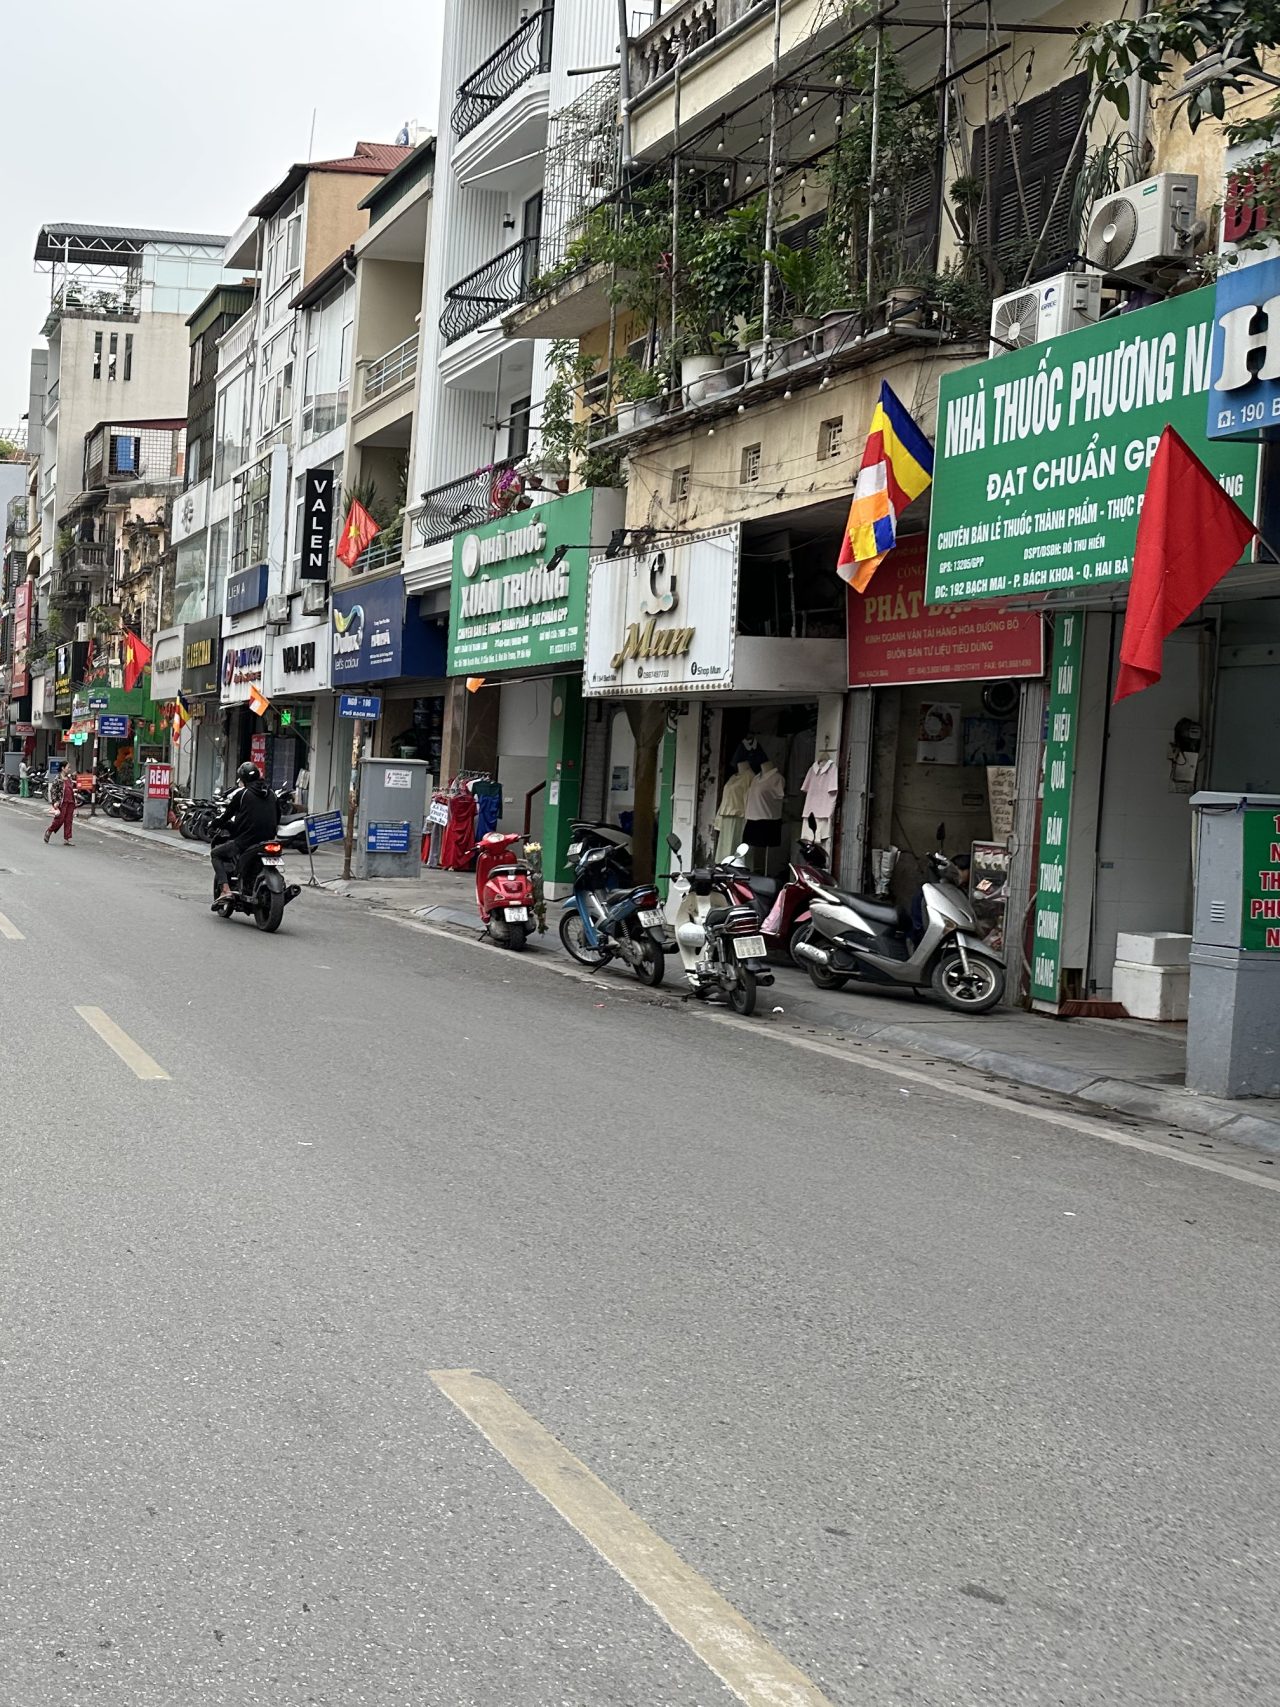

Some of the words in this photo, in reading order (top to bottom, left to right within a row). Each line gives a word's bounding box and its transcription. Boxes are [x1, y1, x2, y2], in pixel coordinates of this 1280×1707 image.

[944, 379, 985, 458] NHÀ
[993, 347, 1063, 446] THUỐC
[1069, 332, 1176, 426] PHƯƠNG
[1240, 402, 1265, 424] 190
[986, 466, 1027, 506] ĐẠT
[1033, 433, 1117, 492] CHUẨN
[1124, 436, 1161, 472] GP
[1219, 473, 1244, 498] ĂNG
[309, 479, 329, 567] VALEN
[480, 529, 506, 566] NHÀ
[506, 512, 547, 557] THUỐC
[937, 525, 969, 550] CHUYÊN
[971, 521, 989, 543] BÁN
[990, 516, 1002, 539] LẺ
[1003, 509, 1032, 538] THUỐC
[1034, 507, 1066, 533] THÀNH
[1067, 497, 1098, 527] PHẨM
[1107, 494, 1135, 524] THỰC
[460, 574, 502, 618] XUÂN
[503, 558, 569, 610] TRƯỜNG
[935, 586, 949, 599] ĐC:
[950, 583, 965, 597] 192
[966, 580, 988, 596] BẠCH
[989, 576, 1006, 590] MAI
[1023, 569, 1047, 586] BÁCH
[1049, 567, 1074, 583] KHOA
[1083, 565, 1092, 579] Q.
[1095, 562, 1112, 577] HAI
[1115, 557, 1128, 575] BÀ
[864, 584, 922, 624] PHÁT
[610, 618, 696, 669] Mun
[882, 631, 906, 643] DOANH
[1063, 615, 1075, 648] TƯ
[283, 641, 316, 674] VALEN
[1058, 655, 1074, 695] VẤN
[1052, 707, 1071, 748] HIỆU
[1051, 751, 1066, 790] QUẢ
[1046, 810, 1063, 846] BÁN
[1040, 853, 1062, 895] THUỐC
[1036, 904, 1060, 941] CHÍNH
